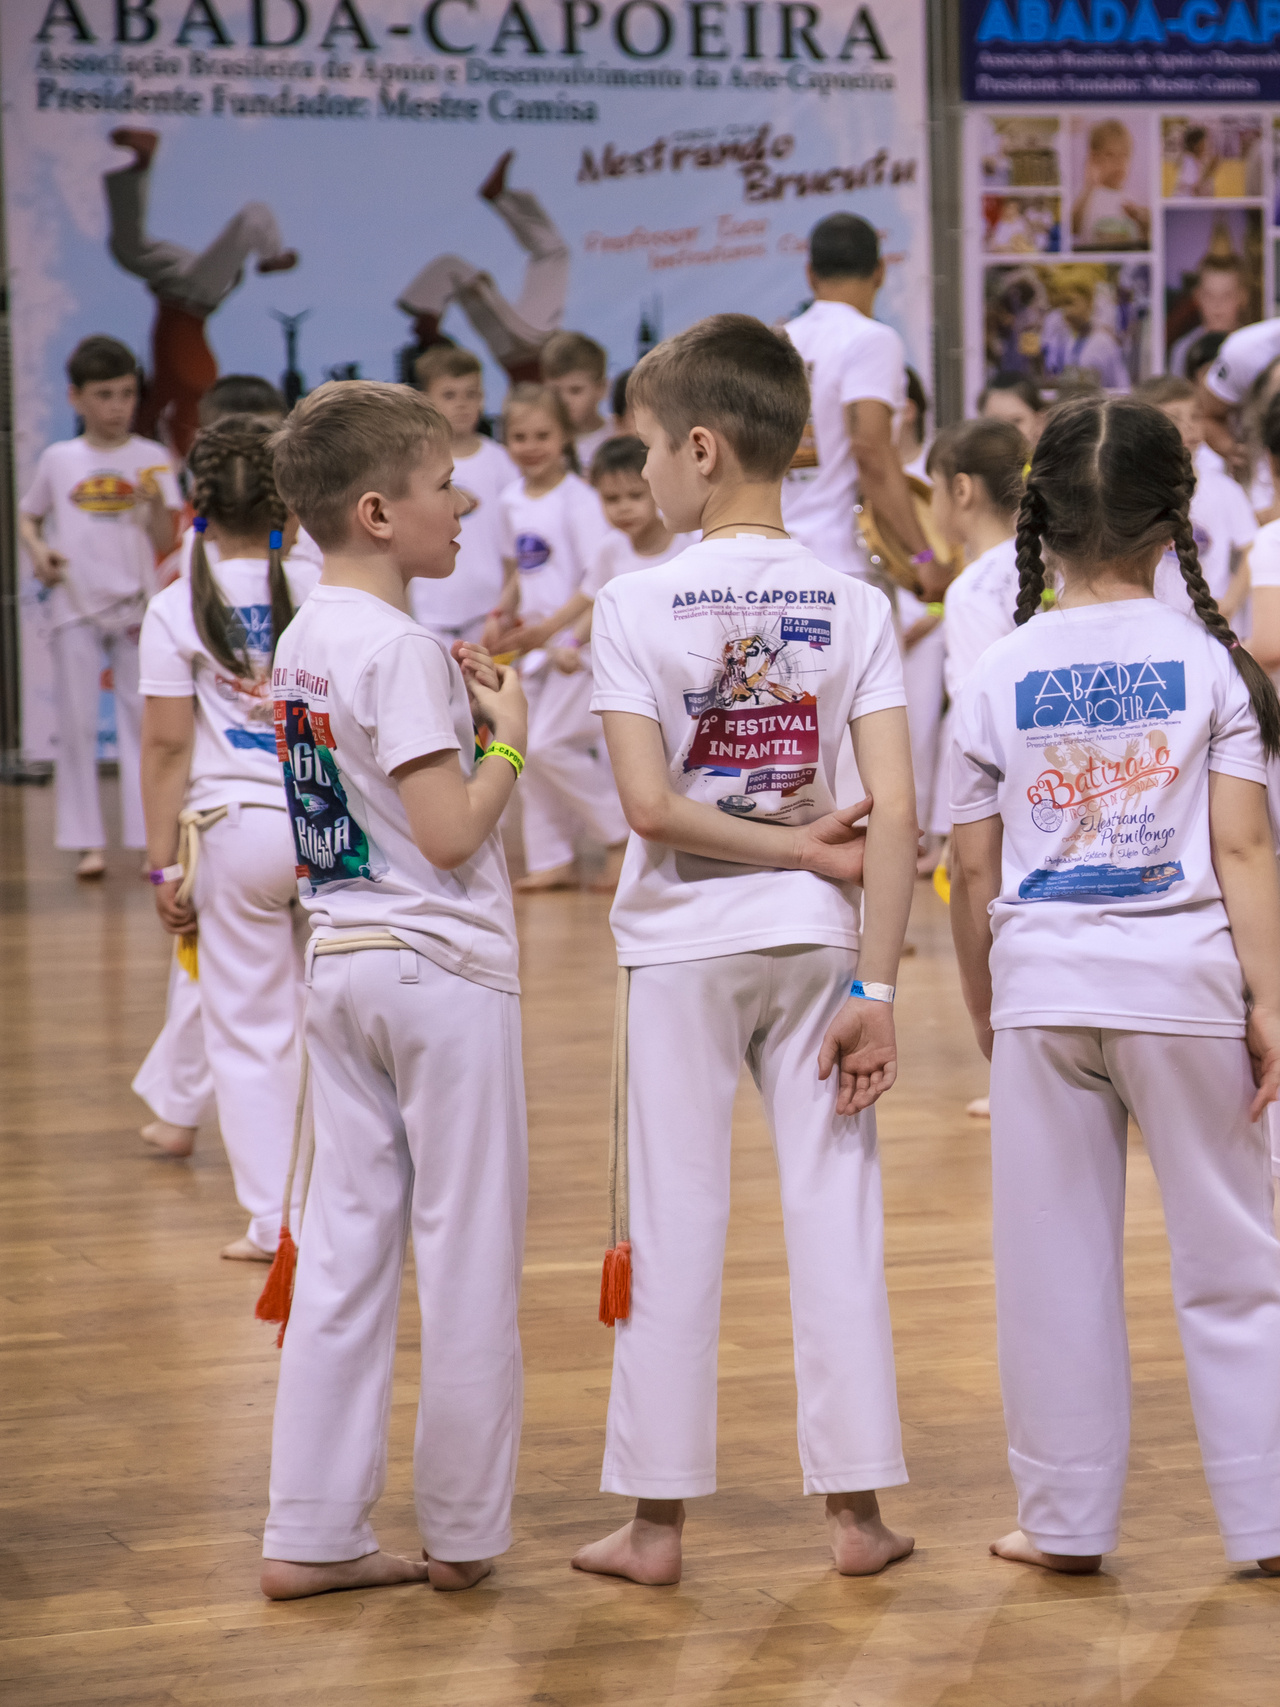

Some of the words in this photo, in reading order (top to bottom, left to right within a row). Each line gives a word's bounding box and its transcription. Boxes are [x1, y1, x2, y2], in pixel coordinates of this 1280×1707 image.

[1034, 654, 1167, 705] ABADÁ
[1033, 691, 1171, 730] CAPOEIRA
[725, 715, 816, 737] FESTIVAL
[708, 739, 802, 760] INFANTIL
[747, 782, 769, 792] PROF.
[771, 777, 806, 789] BRONCO
[749, 773, 769, 784] PROF.
[1101, 824, 1175, 848] Pernilongo
